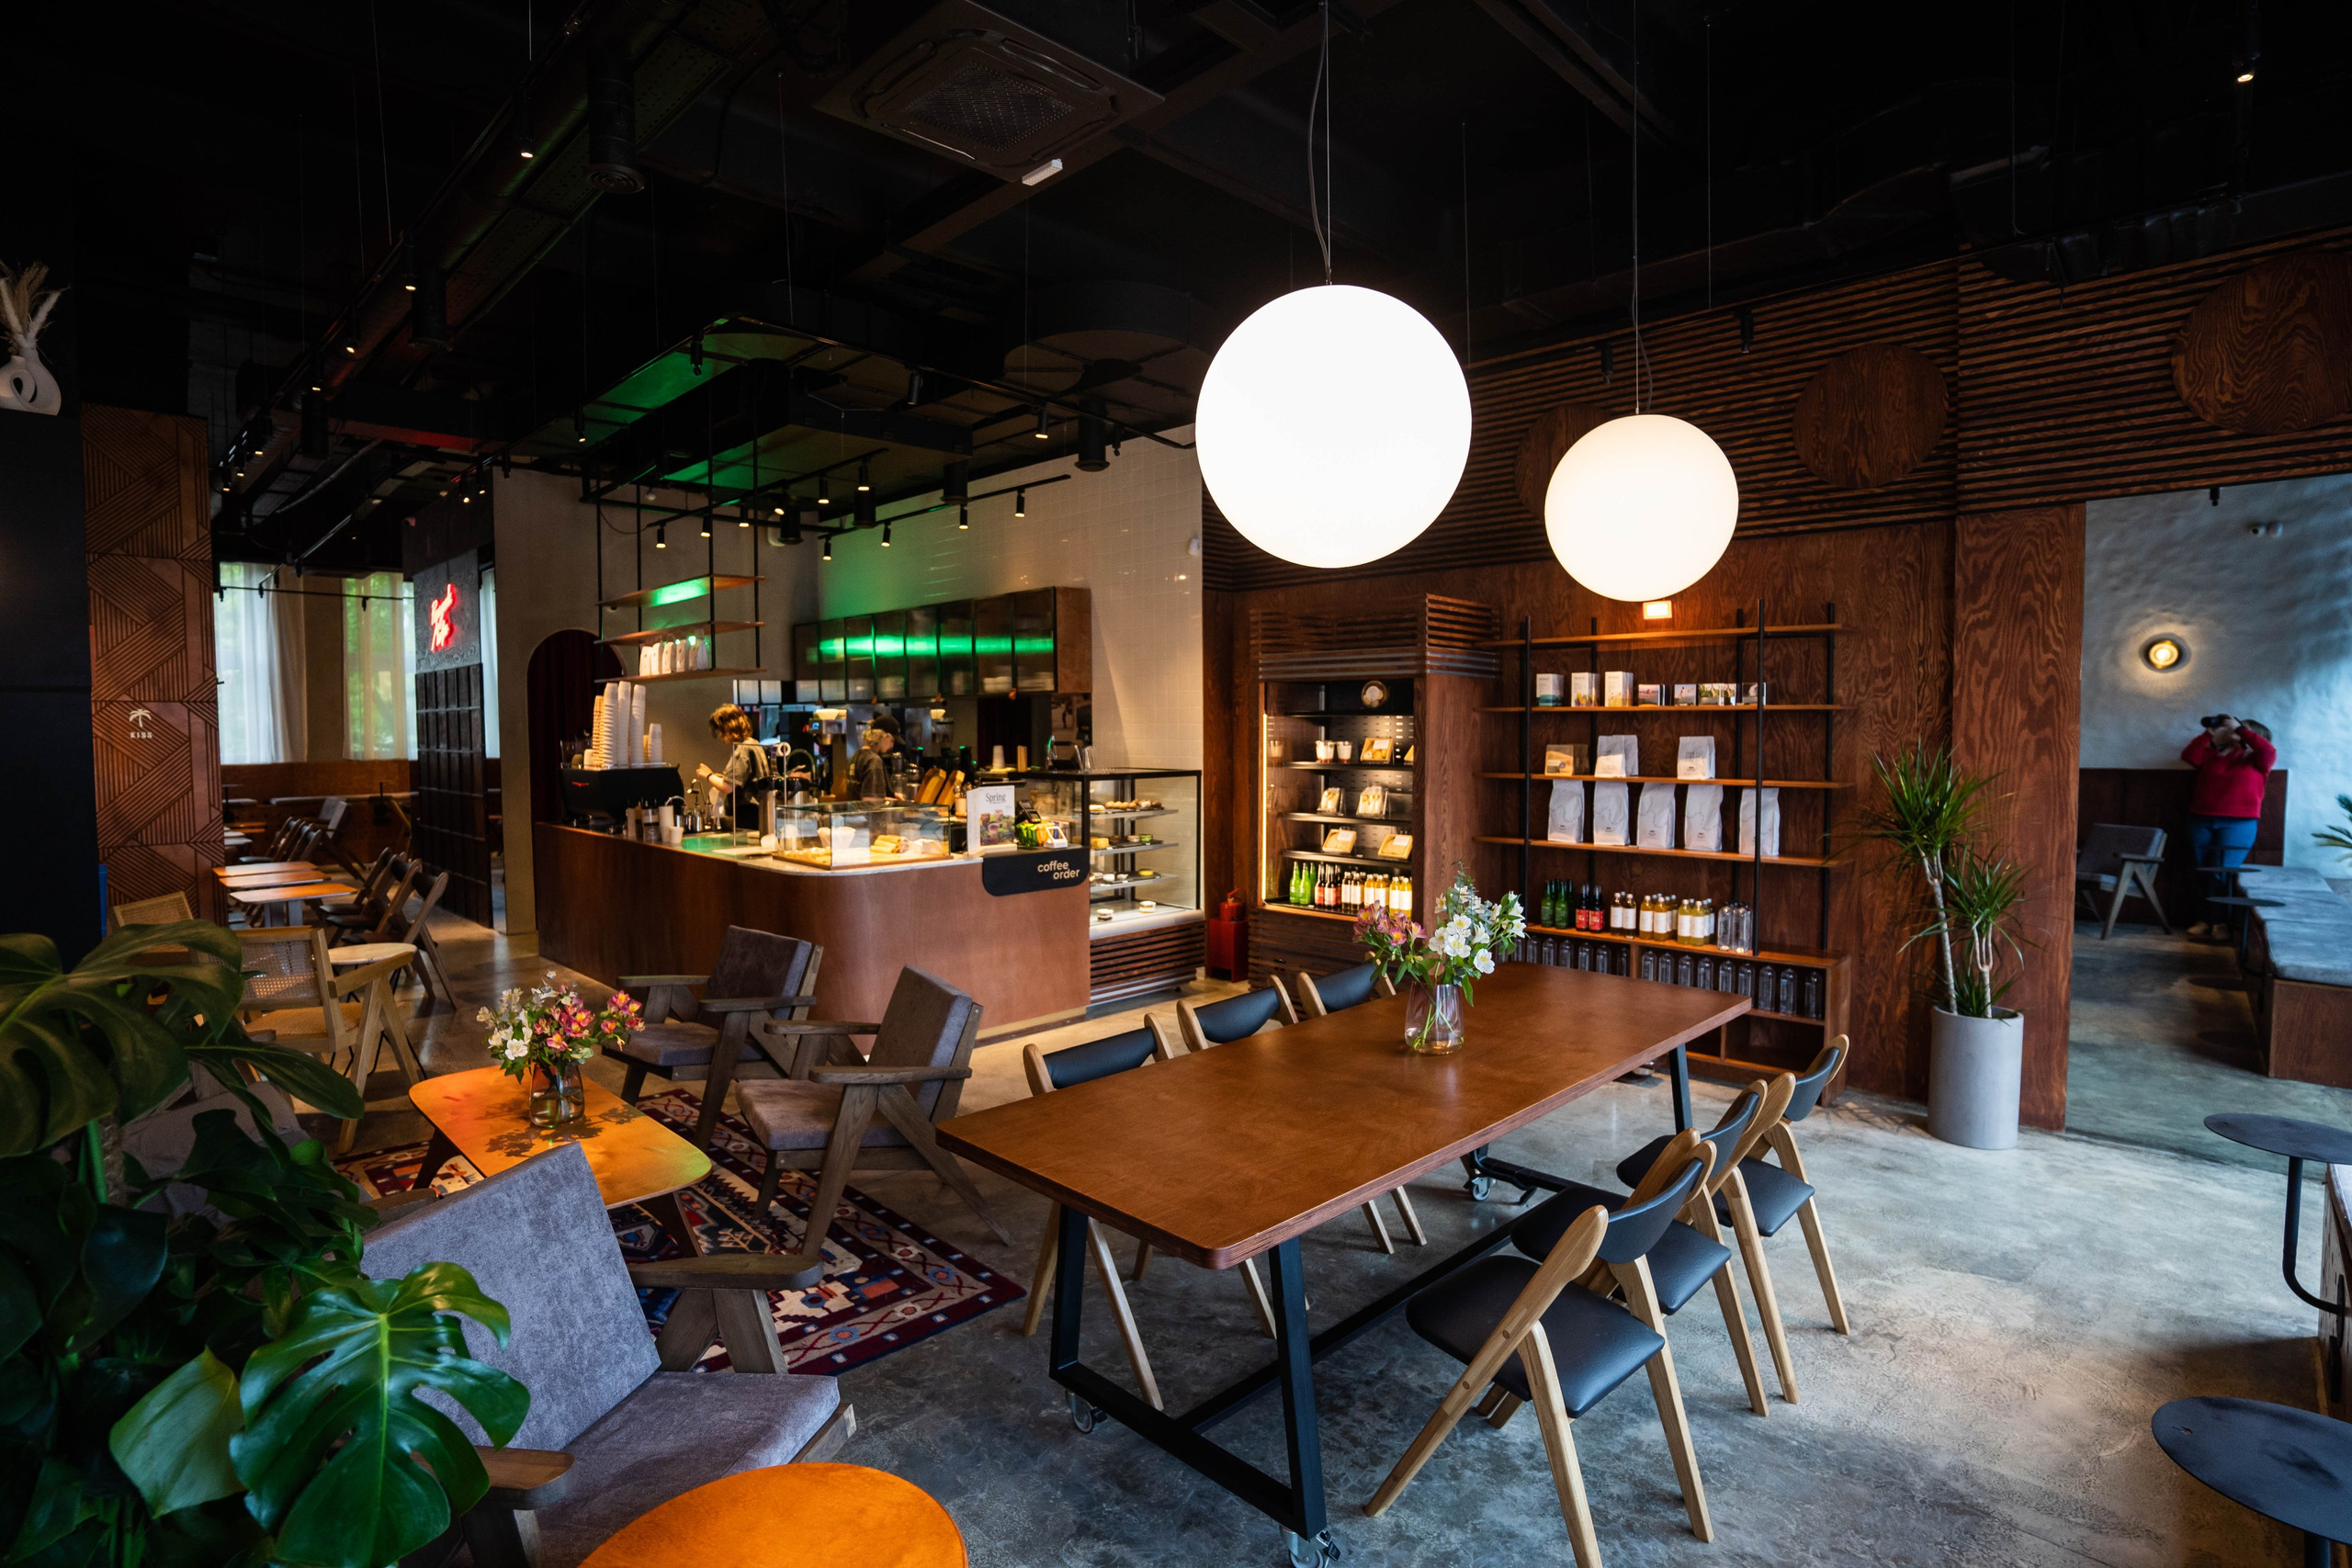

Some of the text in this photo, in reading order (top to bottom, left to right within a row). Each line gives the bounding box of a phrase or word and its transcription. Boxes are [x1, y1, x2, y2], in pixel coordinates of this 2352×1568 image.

[985, 792, 1007, 804] Spring
[1037, 860, 1069, 873] coffee
[1053, 868, 1080, 880] order
